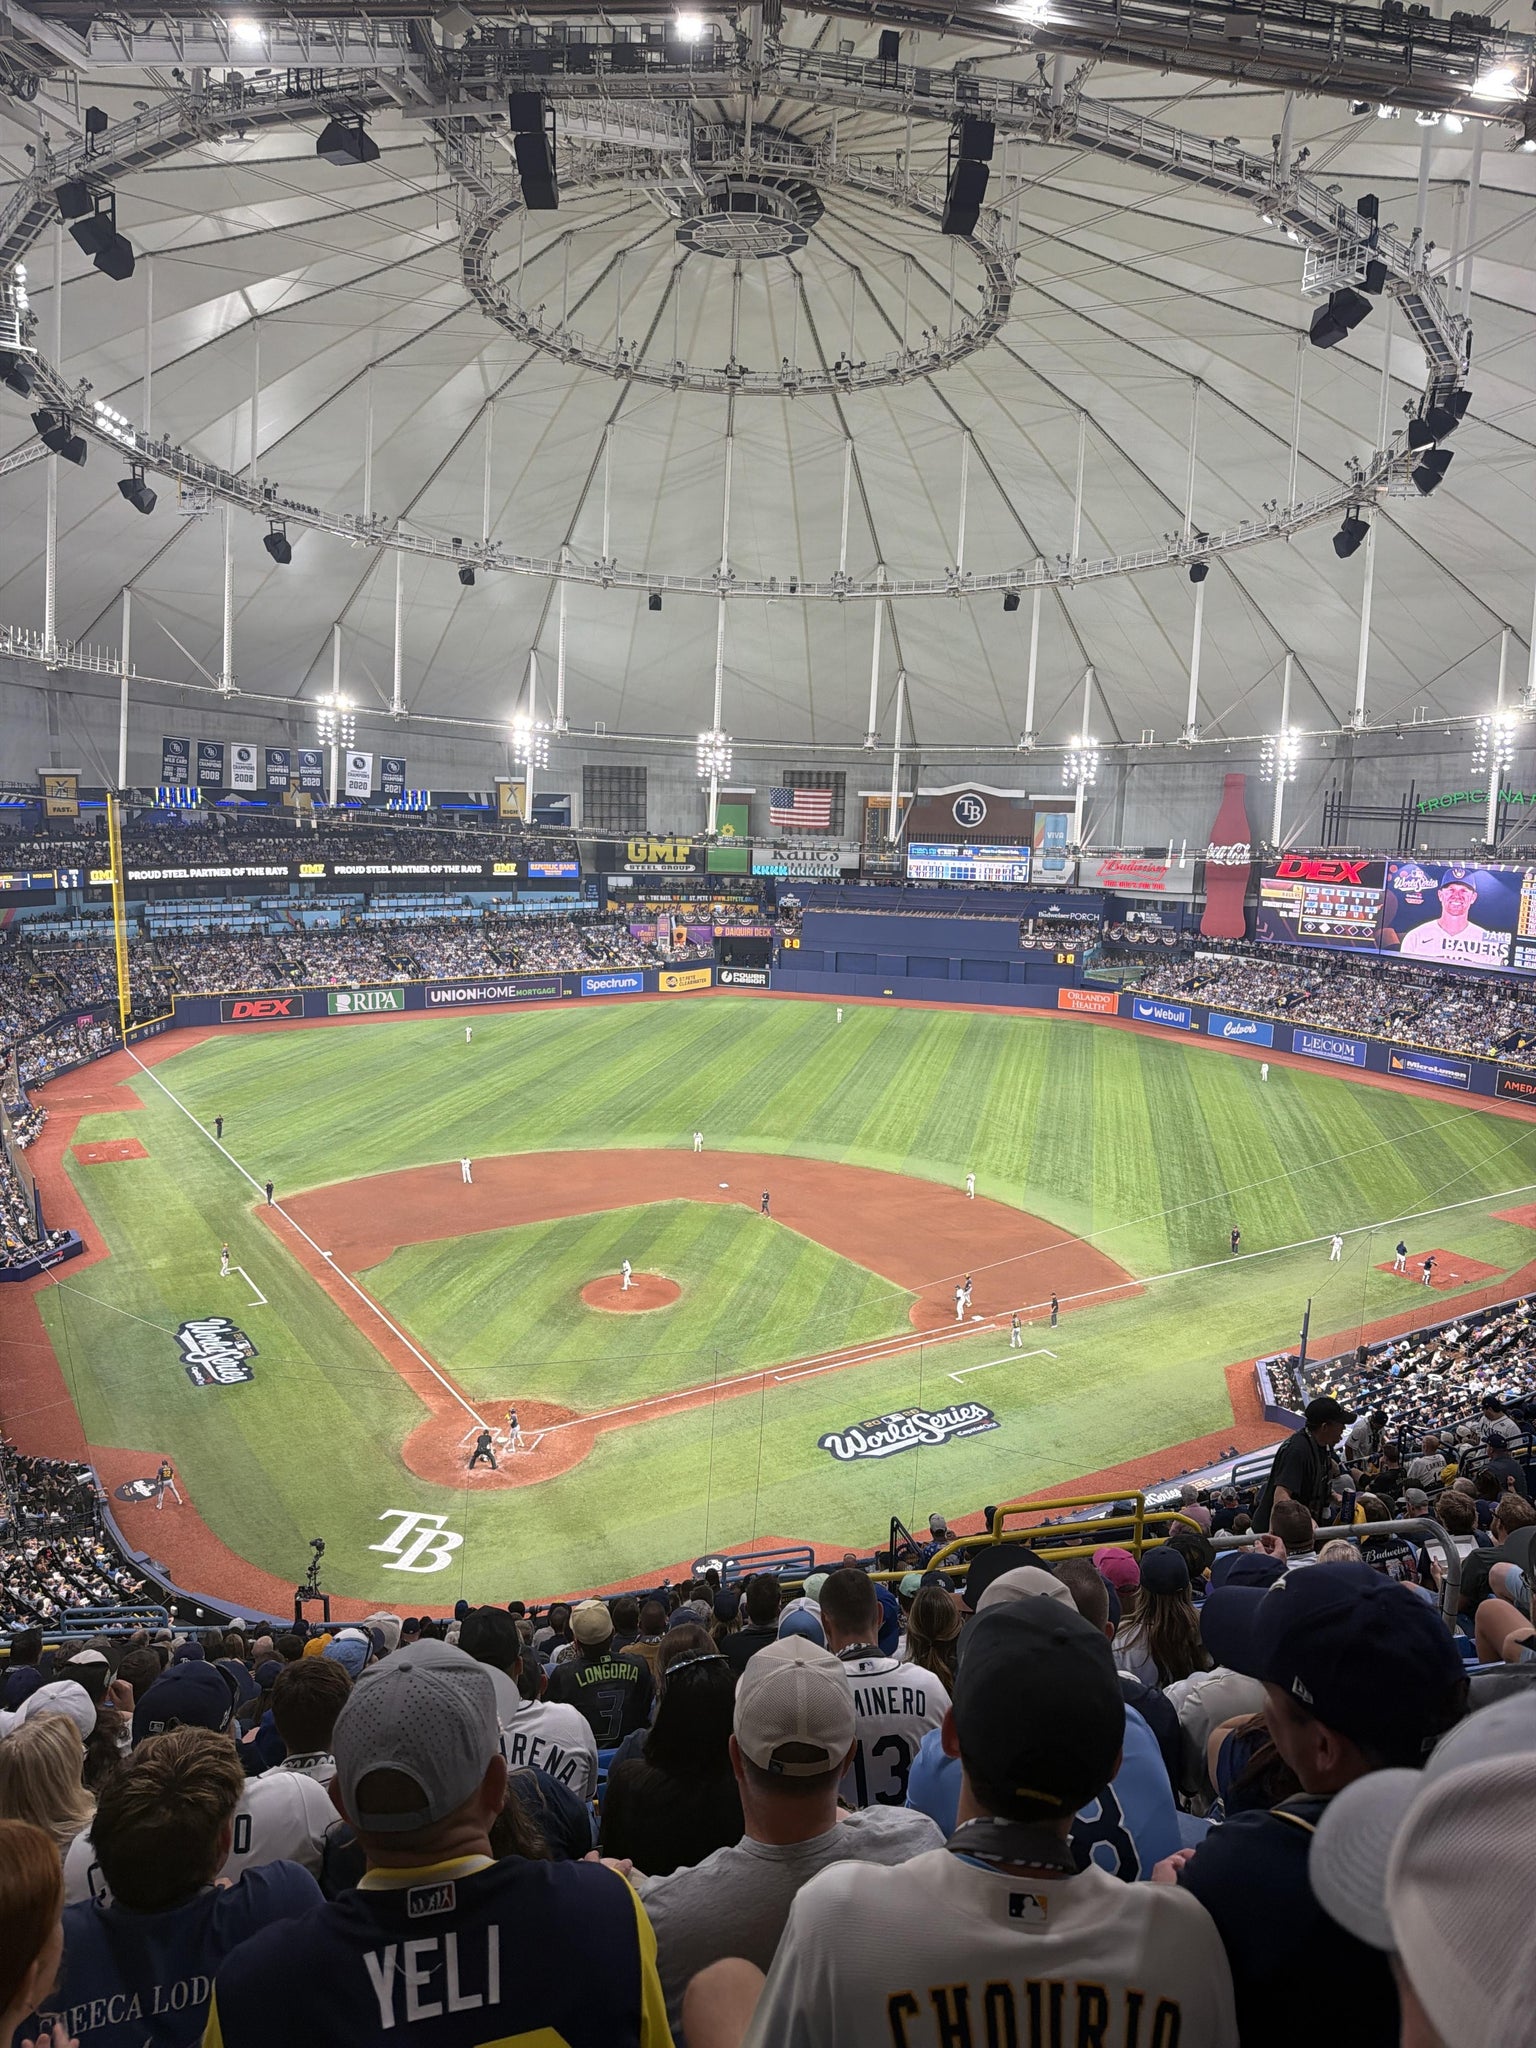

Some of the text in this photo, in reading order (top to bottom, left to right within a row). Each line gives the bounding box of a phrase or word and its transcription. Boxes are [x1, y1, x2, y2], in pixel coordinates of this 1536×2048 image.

[200, 770, 220, 781] 2008
[234, 774, 254, 783] 2008
[269, 776, 287, 786] 2010
[302, 777, 321, 787] 2020
[349, 780, 368, 791] 2020
[959, 799, 982, 822] TB
[1417, 788, 1525, 815] TROPICNA
[626, 837, 693, 864] GMF
[128, 869, 161, 880] PROUD
[162, 868, 190, 879] STEEL
[190, 867, 232, 878] PARTNER
[232, 867, 245, 877] OF
[245, 867, 265, 877] THE
[266, 866, 288, 876] RAYS
[334, 865, 366, 875] PROUD
[366, 865, 391, 874] STEEL
[391, 865, 430, 874] PARTNER
[430, 865, 443, 874] OF
[443, 865, 460, 874] THE
[460, 864, 482, 874] RAYS
[1275, 854, 1370, 884] DEX
[1038, 911, 1100, 921] Budweiser PORCH
[725, 927, 772, 937] DAIQUIRI DECK
[1483, 930, 1512, 944] JAKE
[1443, 938, 1510, 959] BAUERS
[516, 986, 557, 996] MORTGAGE
[586, 977, 634, 992] Spectrum
[352, 991, 399, 1011] RIPA
[1067, 991, 1111, 1004] ORLANDO
[1071, 999, 1106, 1011] HEALTH
[232, 998, 294, 1019] DEX
[1154, 1006, 1186, 1024] Webull
[1223, 1020, 1258, 1036] Culver's
[1406, 1059, 1467, 1079] MicroLumen
[824, 1403, 988, 1459] World Series
[368, 1508, 464, 1573] TB
[1364, 1546, 1410, 1563] Budweiser
[575, 1663, 639, 1688] LONGORIA
[854, 1686, 926, 1717] MINERO
[592, 1689, 626, 1741] 3
[853, 1734, 911, 1807] 13
[362, 1924, 500, 2030] YELI
[151, 1975, 216, 2016] LOD
